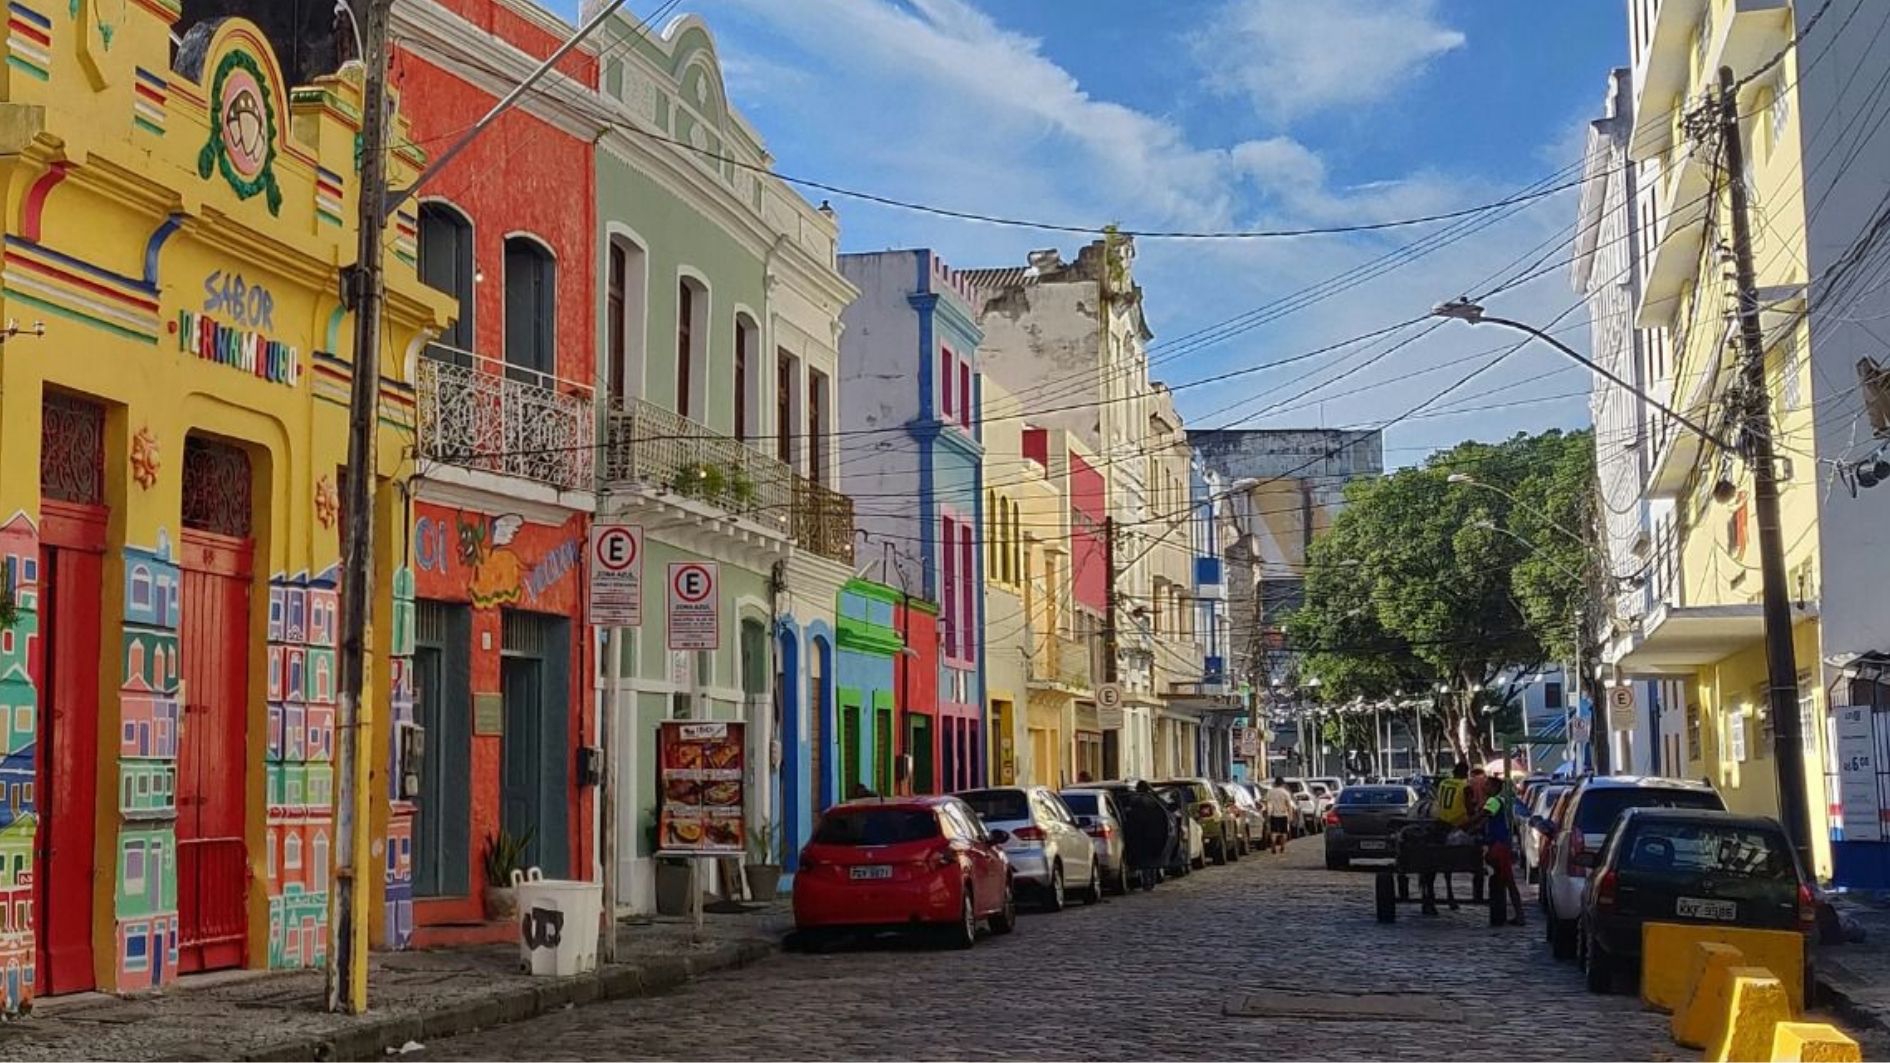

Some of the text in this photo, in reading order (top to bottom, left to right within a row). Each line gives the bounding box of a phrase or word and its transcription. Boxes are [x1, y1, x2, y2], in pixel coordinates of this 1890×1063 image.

[203, 269, 274, 333] SABOR
[609, 536, 624, 561] E
[686, 572, 700, 595] E
[1104, 690, 1113, 703] E
[1617, 693, 1627, 705] E
[1441, 784, 1457, 809] 10
